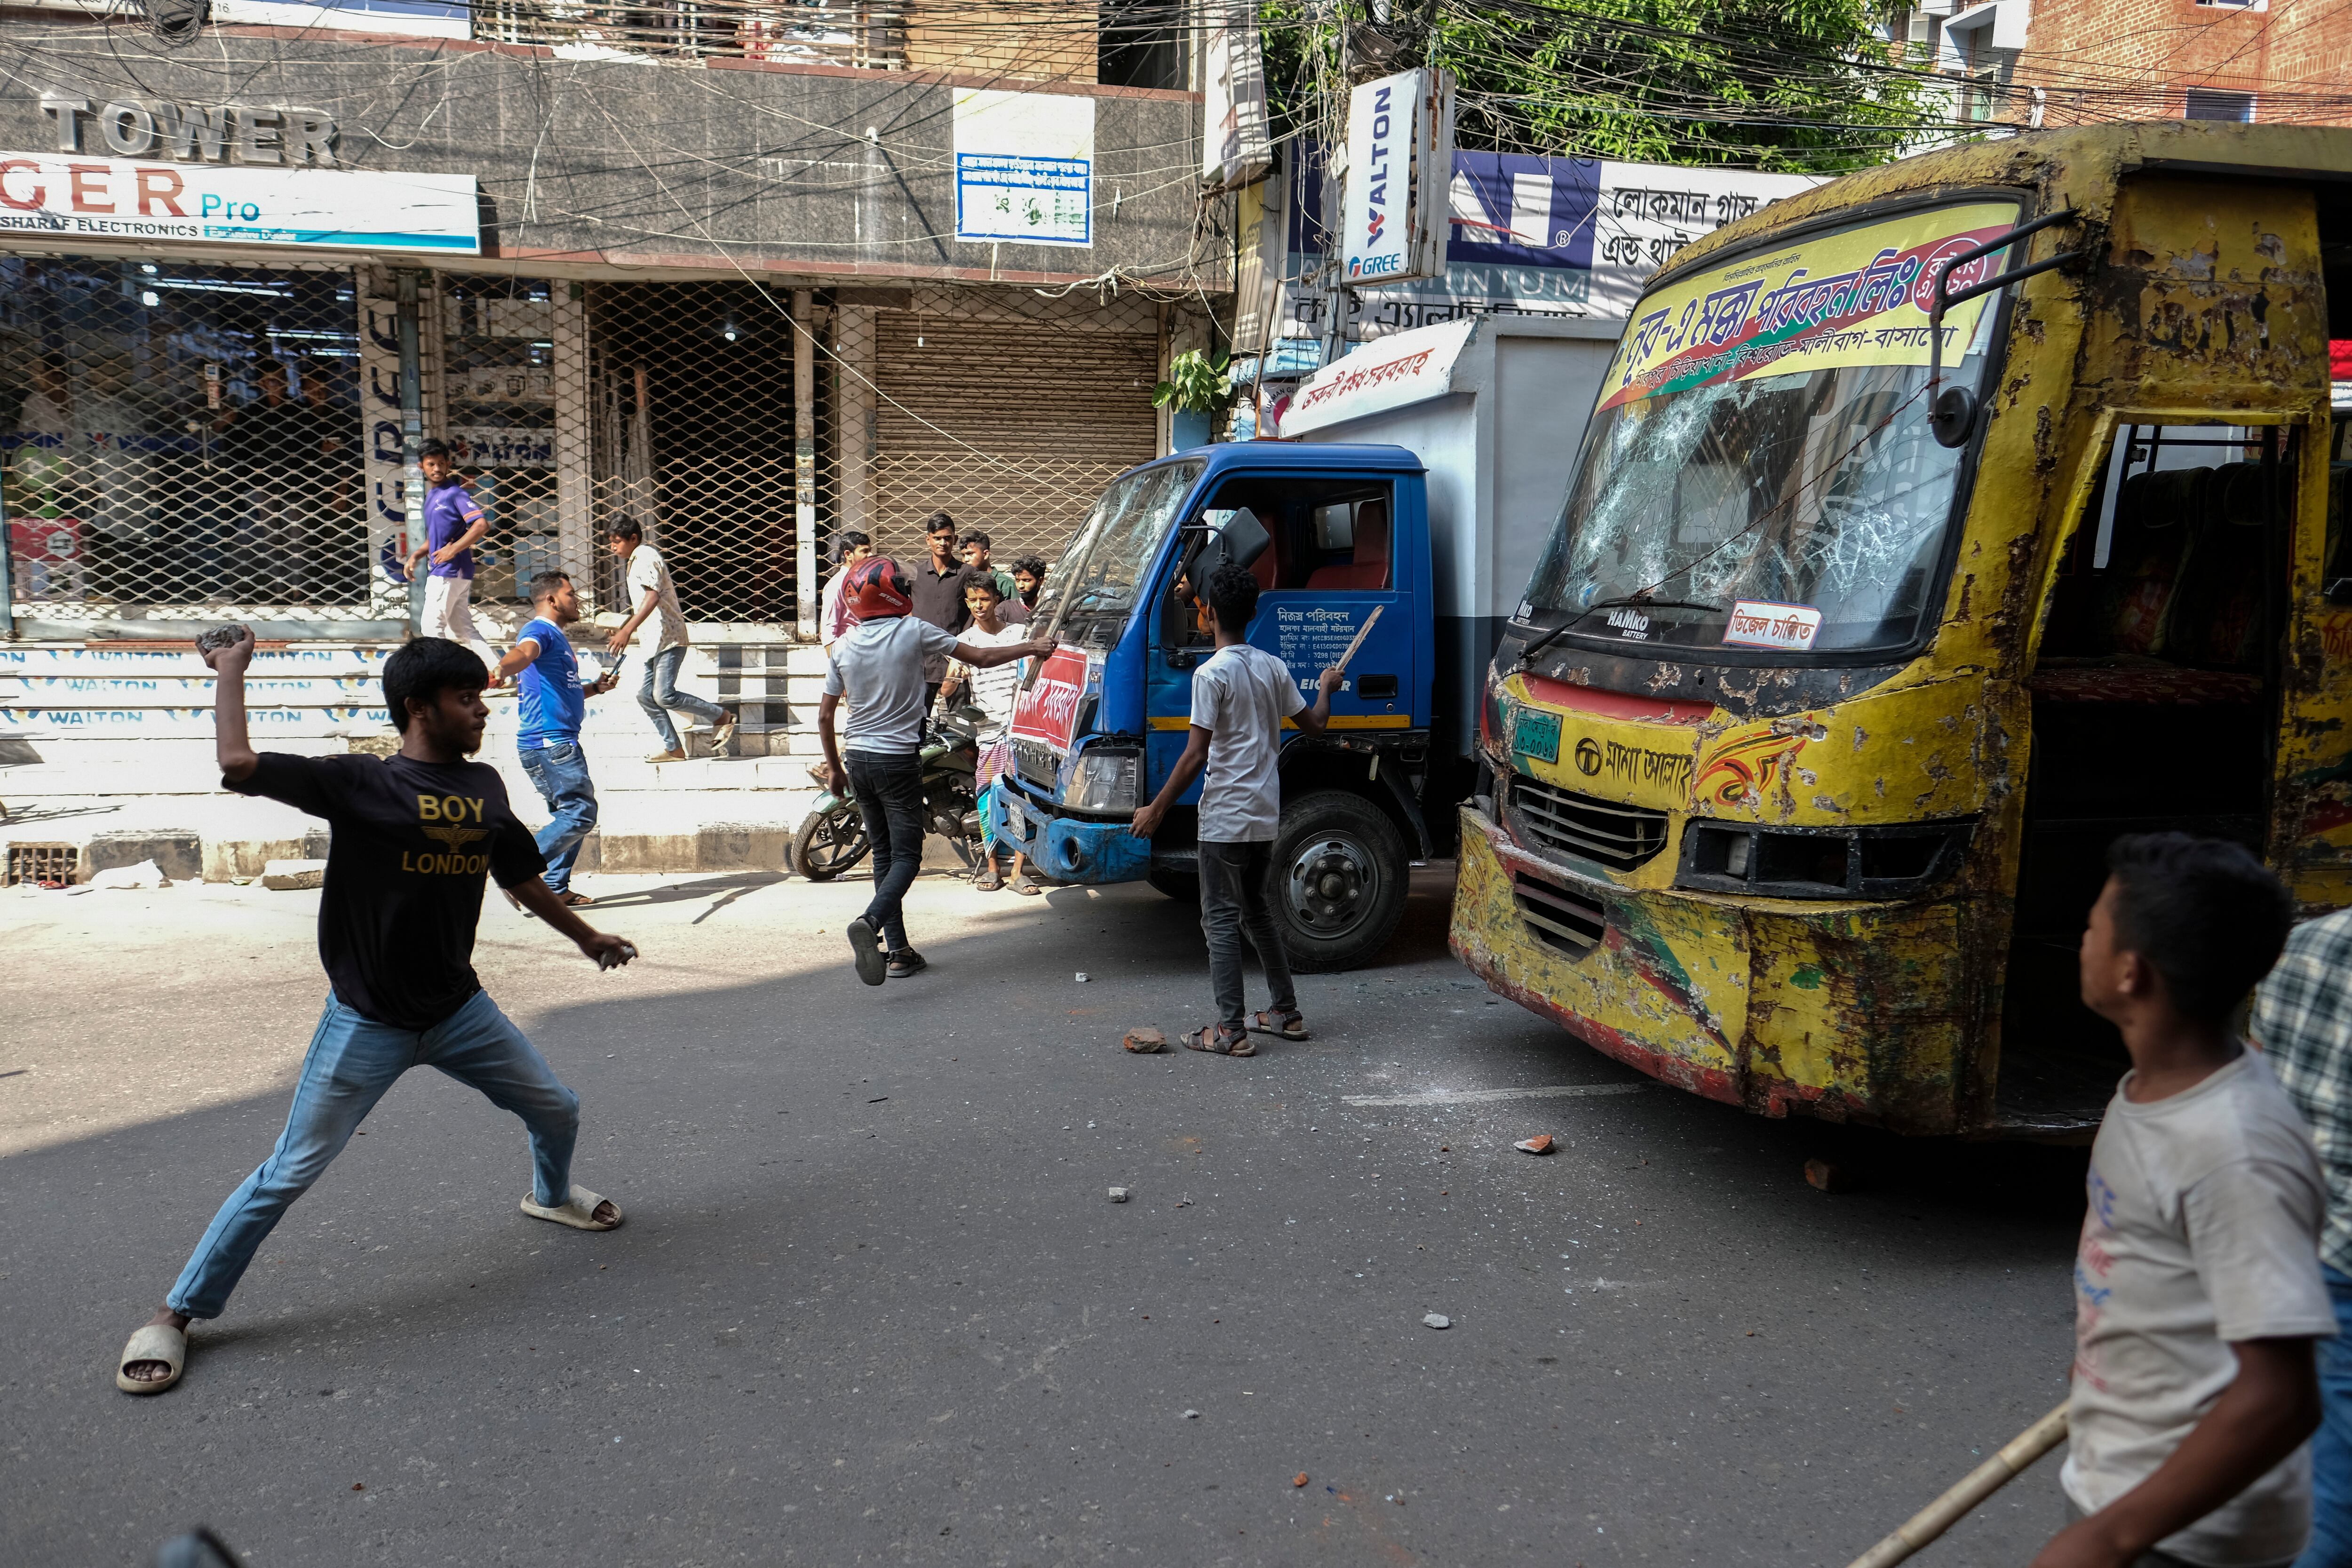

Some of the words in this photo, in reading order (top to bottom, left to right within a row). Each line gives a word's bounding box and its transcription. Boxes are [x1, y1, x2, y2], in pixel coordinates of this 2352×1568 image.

[40, 93, 340, 165] TOWER
[1367, 86, 1391, 248] WALTON
[201, 193, 260, 221] Pro
[1612, 185, 1711, 226] লোকমান
[78, 219, 198, 236] ELECTRONICS
[1362, 254, 1401, 275] GREE
[1754, 268, 1862, 334] পরিবহন
[1277, 607, 1303, 621] নিজস্ব
[1306, 608, 1350, 622] পরিবহন
[1606, 610, 1649, 631] HAMKO
[1730, 608, 1770, 637] ডিজেল
[1772, 614, 1815, 641] চালিত
[1303, 623, 1328, 633] মালবাহী
[1621, 629, 1649, 640] BATTERY
[417, 795, 484, 822] BOY
[402, 851, 489, 874] LONDON
